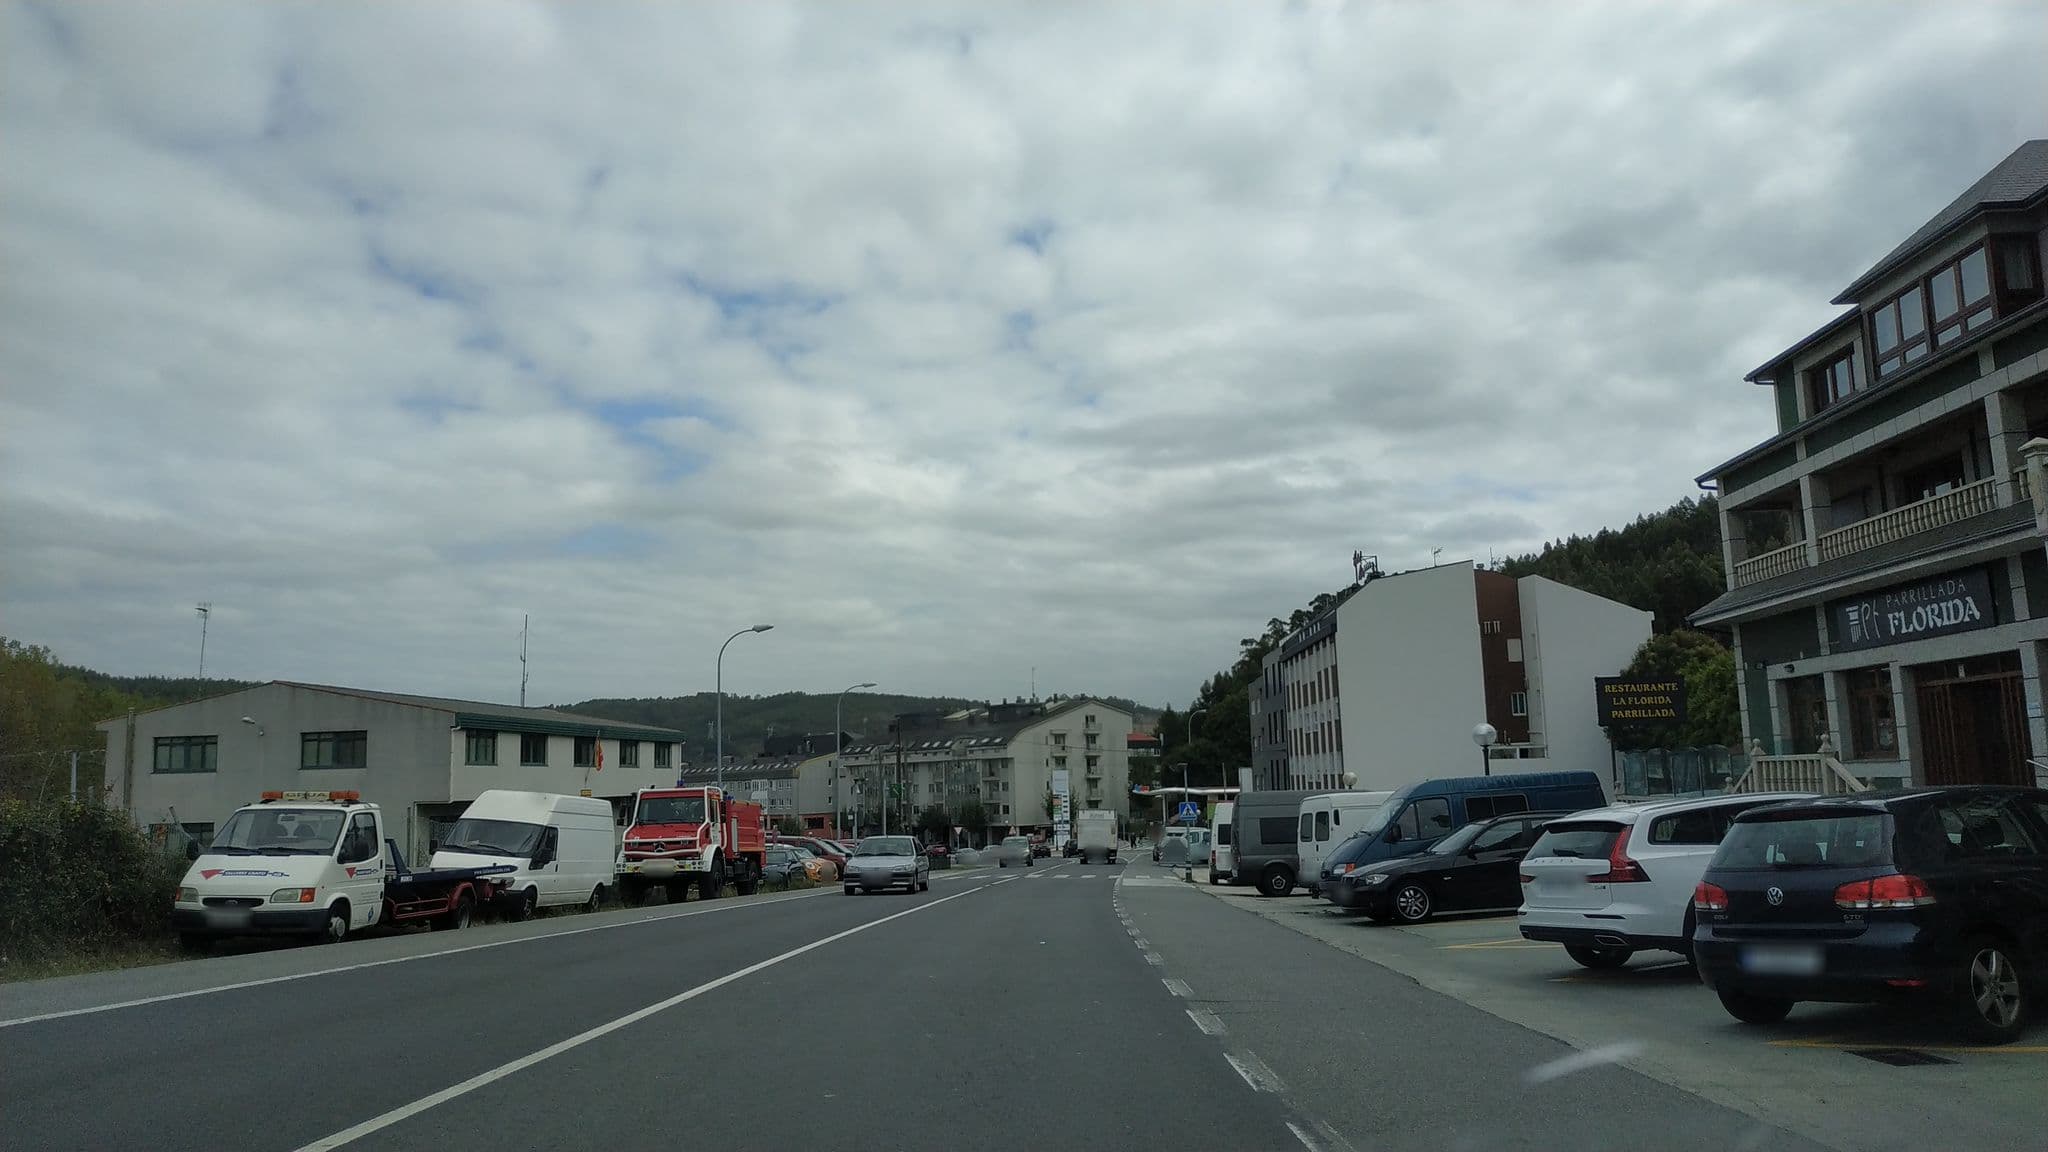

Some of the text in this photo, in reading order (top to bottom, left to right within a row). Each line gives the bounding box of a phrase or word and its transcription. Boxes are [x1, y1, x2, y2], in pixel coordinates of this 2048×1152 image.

[1886, 579, 1966, 608] PARRILLADA
[1887, 596, 1981, 637] FLORIDA
[1604, 682, 1679, 693] RESTAURANTE
[1613, 695, 1672, 706] LA FLORIDA
[1611, 708, 1676, 719] PARRILLADA
